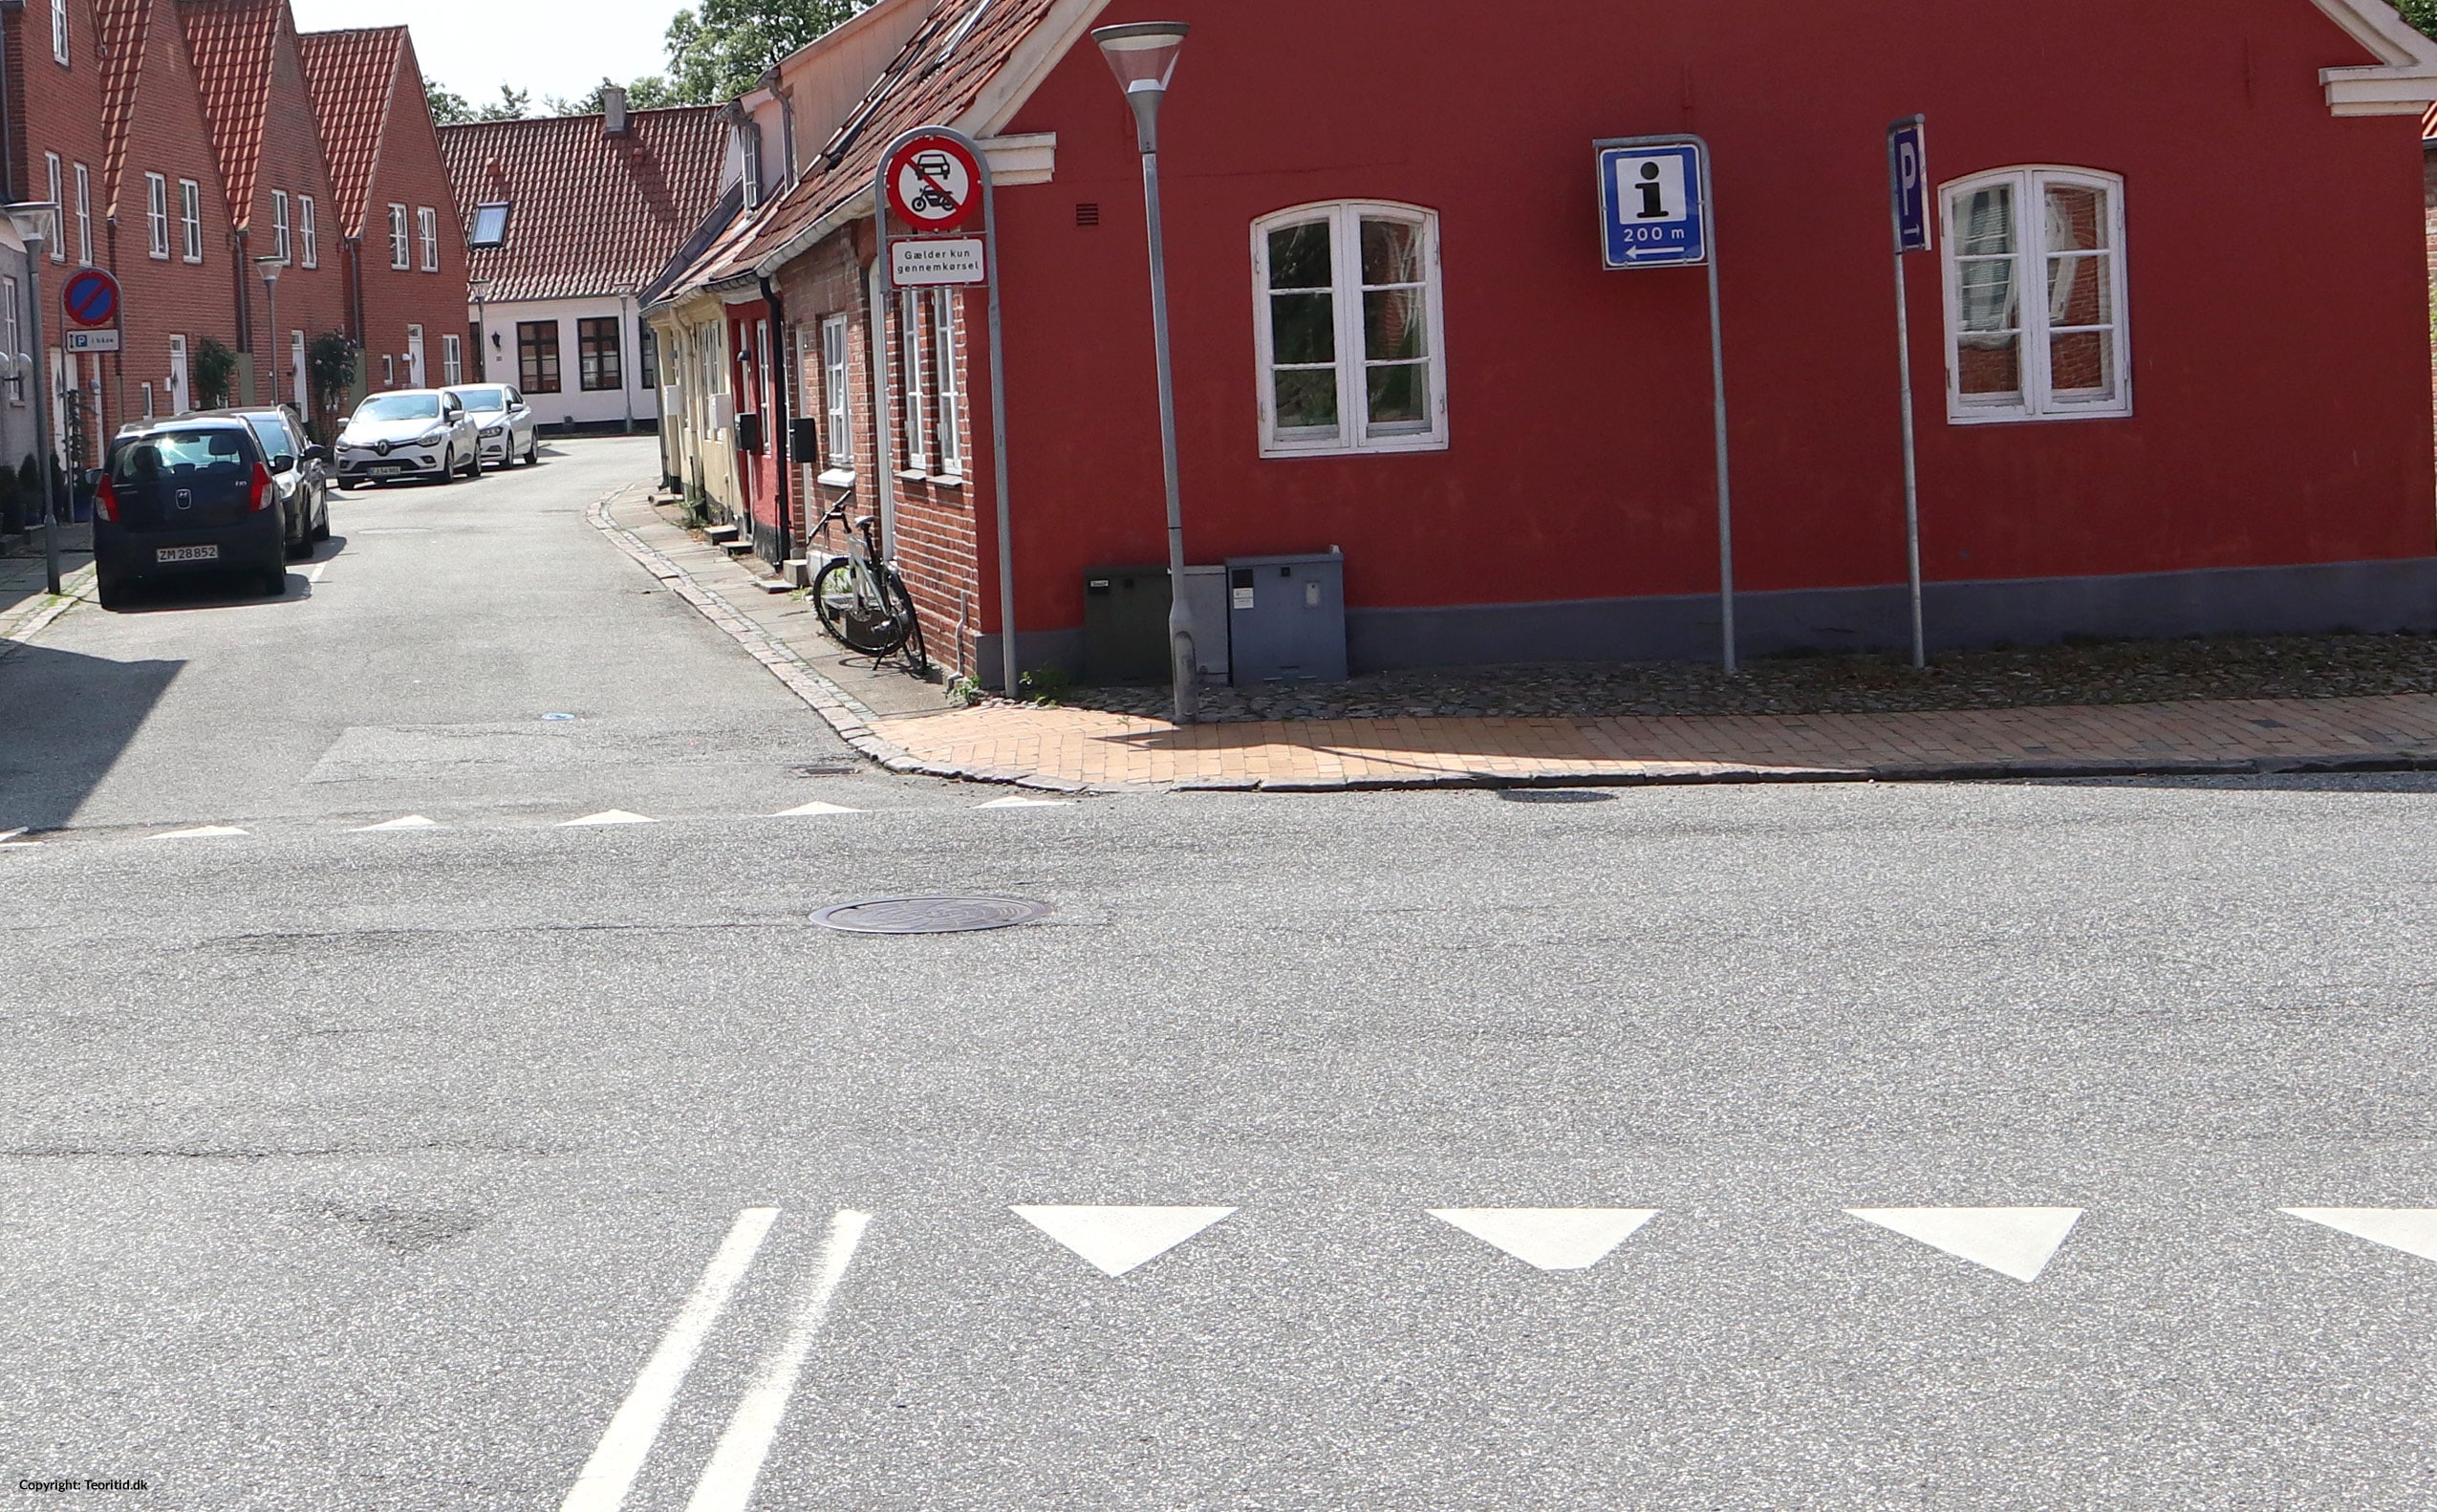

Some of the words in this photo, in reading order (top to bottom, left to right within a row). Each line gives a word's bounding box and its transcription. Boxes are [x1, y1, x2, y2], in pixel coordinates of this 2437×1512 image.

[1624, 227, 1663, 243] 200
[1671, 228, 1685, 240] m
[904, 250, 947, 260] Gælder
[950, 248, 970, 258] kun
[896, 261, 979, 274] gennemkørsel
